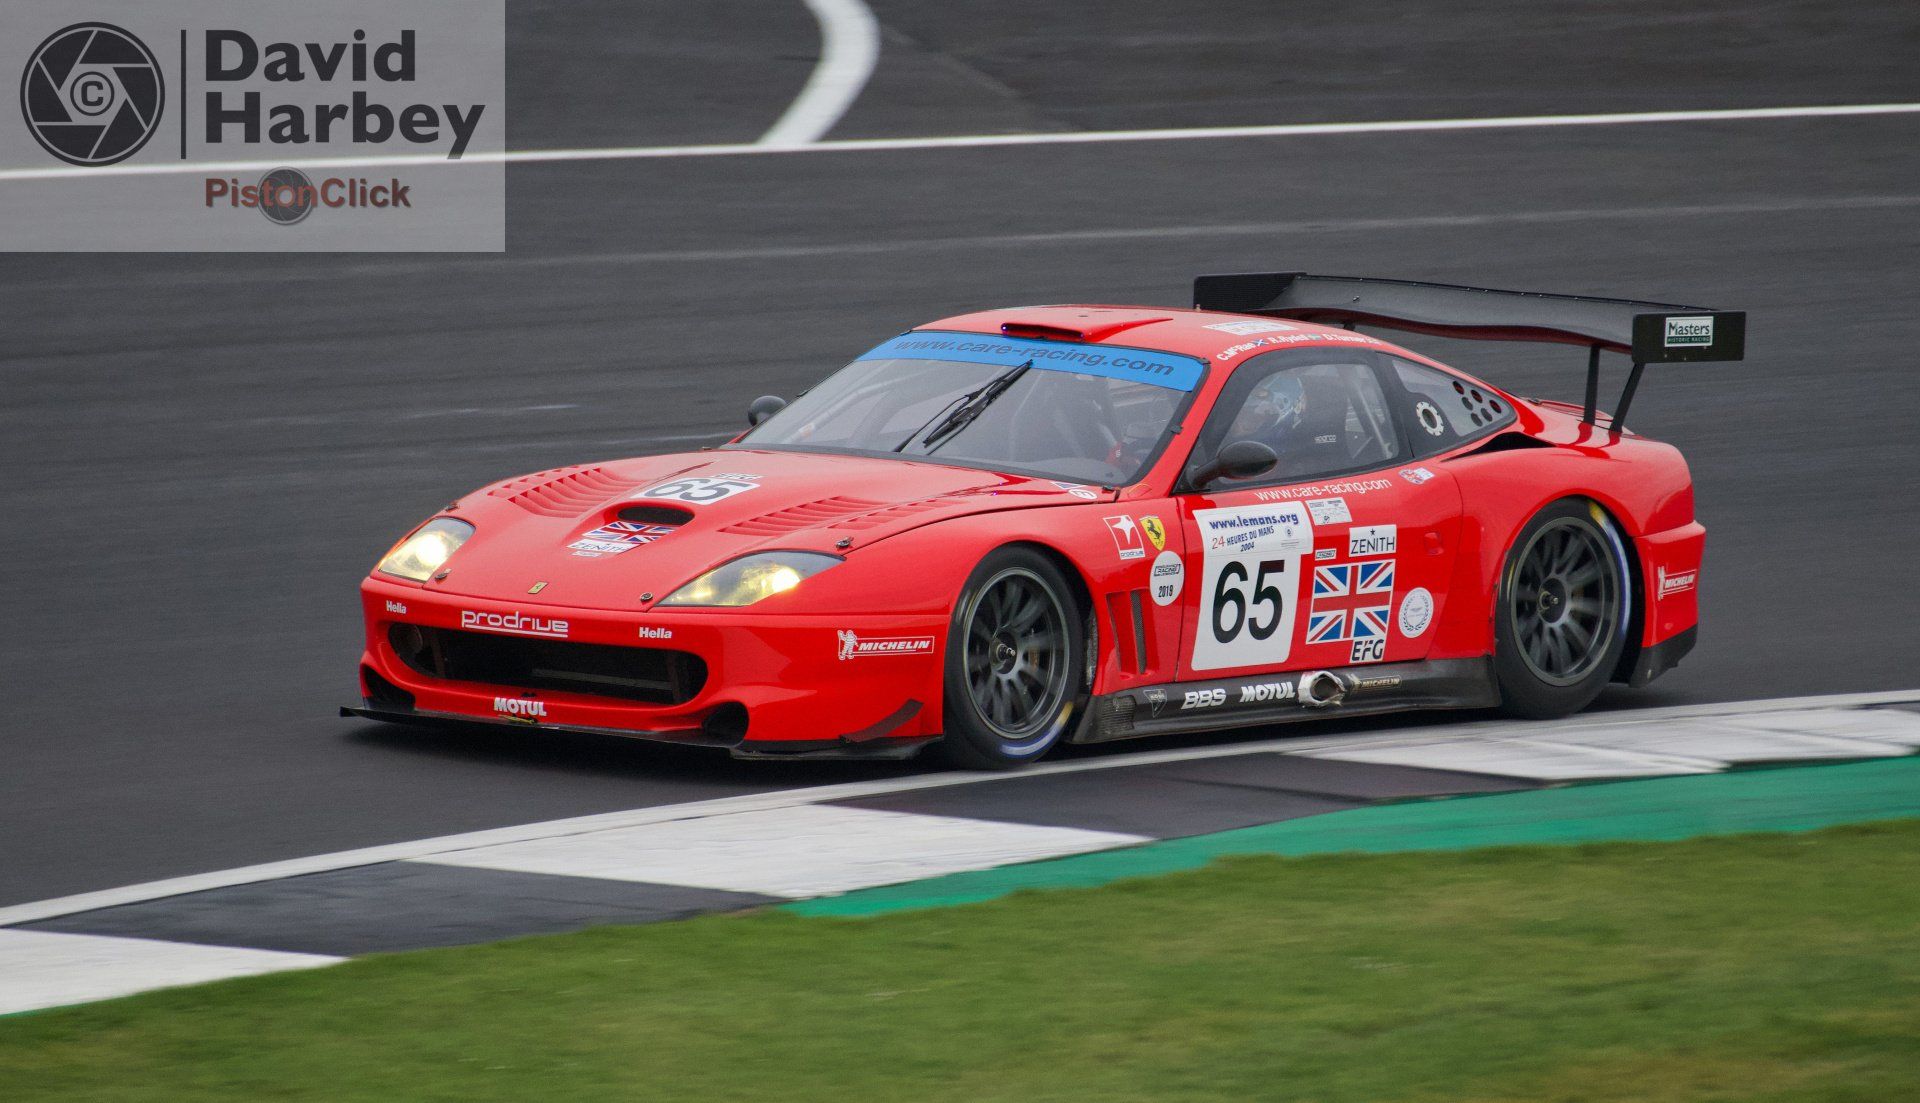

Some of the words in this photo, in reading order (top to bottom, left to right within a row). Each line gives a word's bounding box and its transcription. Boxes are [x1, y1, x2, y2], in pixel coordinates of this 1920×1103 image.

[1668, 322, 1710, 335] Masters
[895, 339, 1176, 377] www.care-racing.com
[644, 477, 752, 501] 65
[1254, 477, 1393, 501] www.care-racing.com
[1209, 513, 1299, 530] www.lemans.org
[1212, 535, 1226, 550] 24
[1226, 532, 1248, 546] HEURES
[1249, 530, 1258, 540] DU
[1258, 526, 1275, 538] MANS
[1240, 542, 1255, 552] 2004
[1350, 536, 1395, 555] ZENITH
[1158, 584, 1174, 598] 2019
[386, 600, 407, 614] Hella
[1212, 559, 1285, 644] 65
[462, 610, 569, 633] prodrive
[638, 626, 672, 639] Hella
[858, 640, 931, 651] MICHELIN
[1352, 639, 1383, 661] EFG
[1239, 681, 1295, 703] MOTUL
[1362, 677, 1400, 688] MICHELIN
[493, 697, 547, 717] MOTUL
[1181, 688, 1227, 709] BBS
